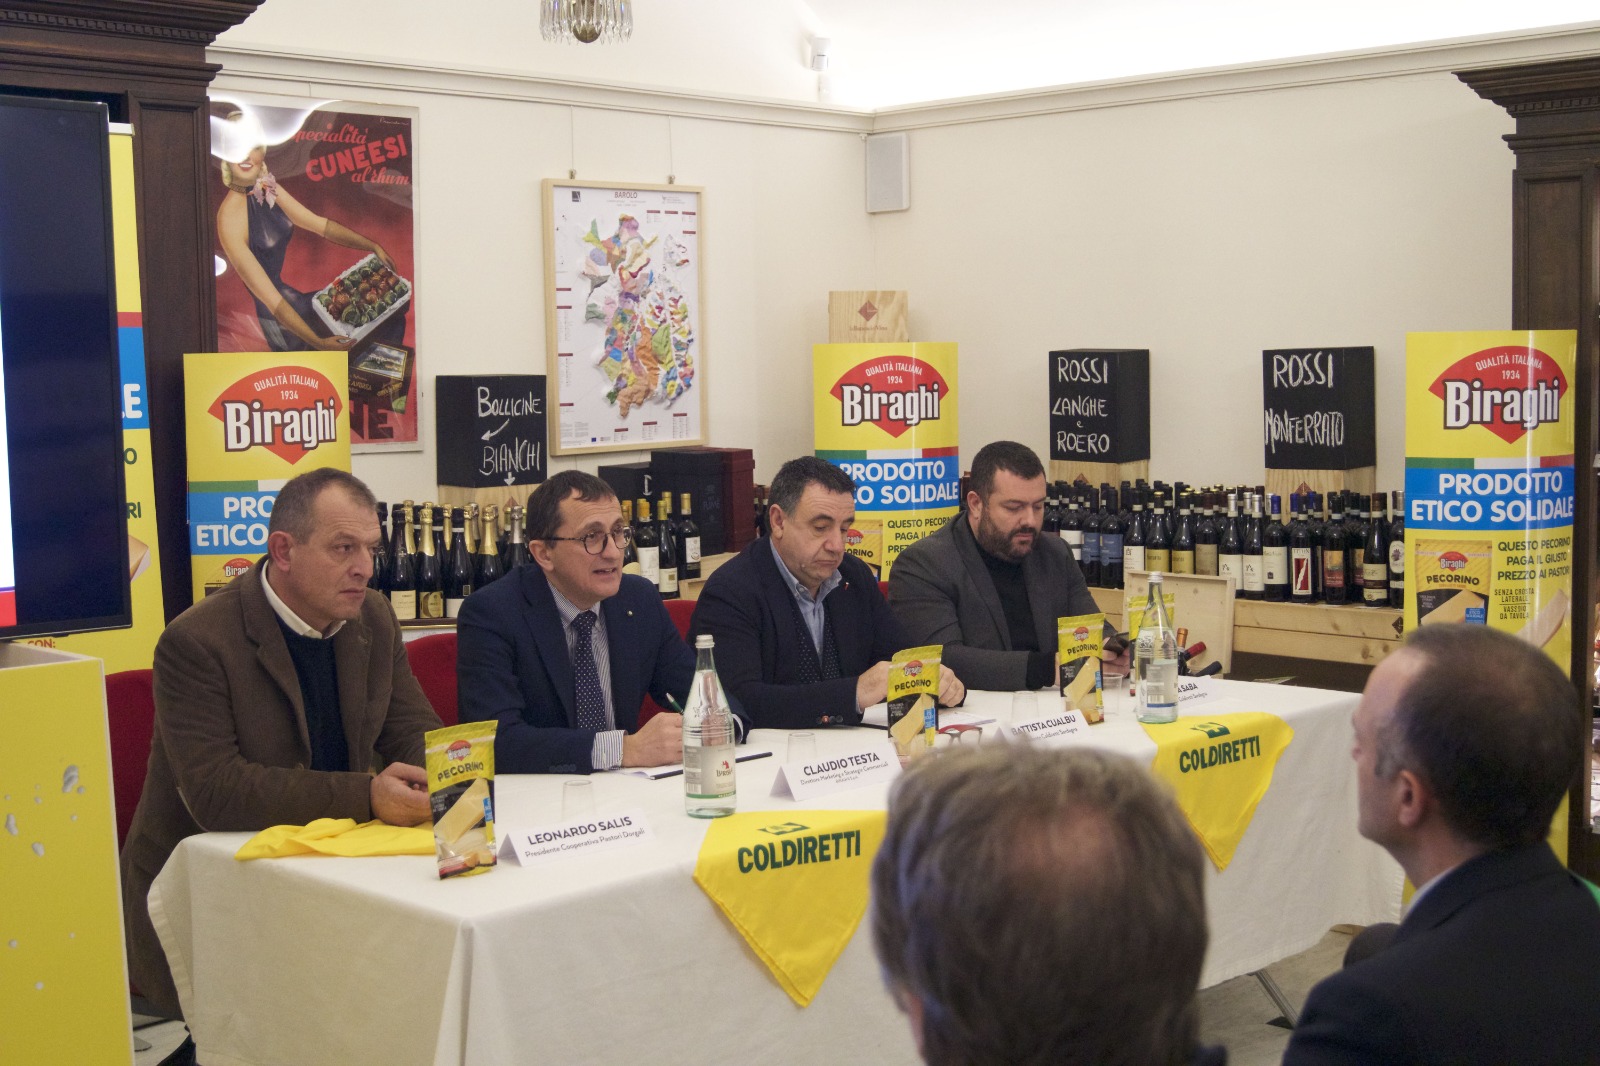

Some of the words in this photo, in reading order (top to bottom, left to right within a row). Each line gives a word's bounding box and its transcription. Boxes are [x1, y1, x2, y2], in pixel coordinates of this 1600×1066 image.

[292, 123, 369, 145] pecialità
[305, 133, 407, 182] CUNEESI
[614, 191, 638, 199] BAROLO
[864, 361, 894, 376] QUALITÀ
[895, 362, 922, 376] ITALIANA
[1057, 356, 1108, 384] ROSSI
[1273, 350, 1333, 388] ROSSI
[1475, 352, 1510, 371] QUALITÀ
[1511, 354, 1543, 370] ITALIANA
[254, 372, 288, 392] QUALITÀ
[289, 374, 319, 390] ITALIANA
[887, 375, 903, 384] 1934
[1501, 370, 1520, 380] 1934
[280, 390, 299, 400] 1934
[477, 386, 542, 418] BOLLICINE
[841, 382, 940, 426] Biraghi
[1052, 395, 1108, 417] LANGHE
[1443, 377, 1559, 429] Biraghi
[222, 396, 337, 451] Biraghi
[1076, 420, 1084, 428] e
[1264, 408, 1344, 454] MONFERRATO
[1057, 430, 1110, 454] ROERO
[479, 436, 540, 476] BIANCHI
[839, 460, 946, 482] PRODOTTO
[880, 481, 959, 505] SOLIDALE
[1439, 471, 1563, 496] PRODOTTO
[1411, 499, 1483, 522] ETICO
[1490, 495, 1573, 522] SOLIDALE
[196, 523, 269, 547] ETICO
[887, 519, 923, 529] QUESTO
[895, 531, 919, 541] PAGA
[1498, 540, 1539, 552] QUESTO
[1541, 537, 1571, 549] PECORINO
[1440, 558, 1465, 569] Biraghi
[1506, 556, 1535, 566] PAGA
[1545, 552, 1567, 564] GIUSTO
[1426, 574, 1480, 586] PECORINO
[1497, 570, 1537, 581] PREZZO
[1494, 588, 1513, 596] SENZA
[1067, 643, 1099, 656] PECORINO
[894, 679, 932, 693] PECORINO
[1181, 682, 1198, 692] SABA
[1046, 714, 1076, 728] CUALBU
[803, 758, 848, 776] CLAUDIO
[848, 752, 880, 767] TESTA
[1179, 735, 1261, 774] COLDIRETTI
[437, 761, 484, 783] PECORINO
[527, 823, 597, 846] LEONARDO
[597, 816, 633, 831] SALIS
[525, 847, 560, 858] Presidente
[560, 839, 599, 851] Cooperativa
[599, 831, 623, 843] Pastori
[622, 827, 646, 839] Dorgali
[737, 829, 861, 874] COLDIRETTI
